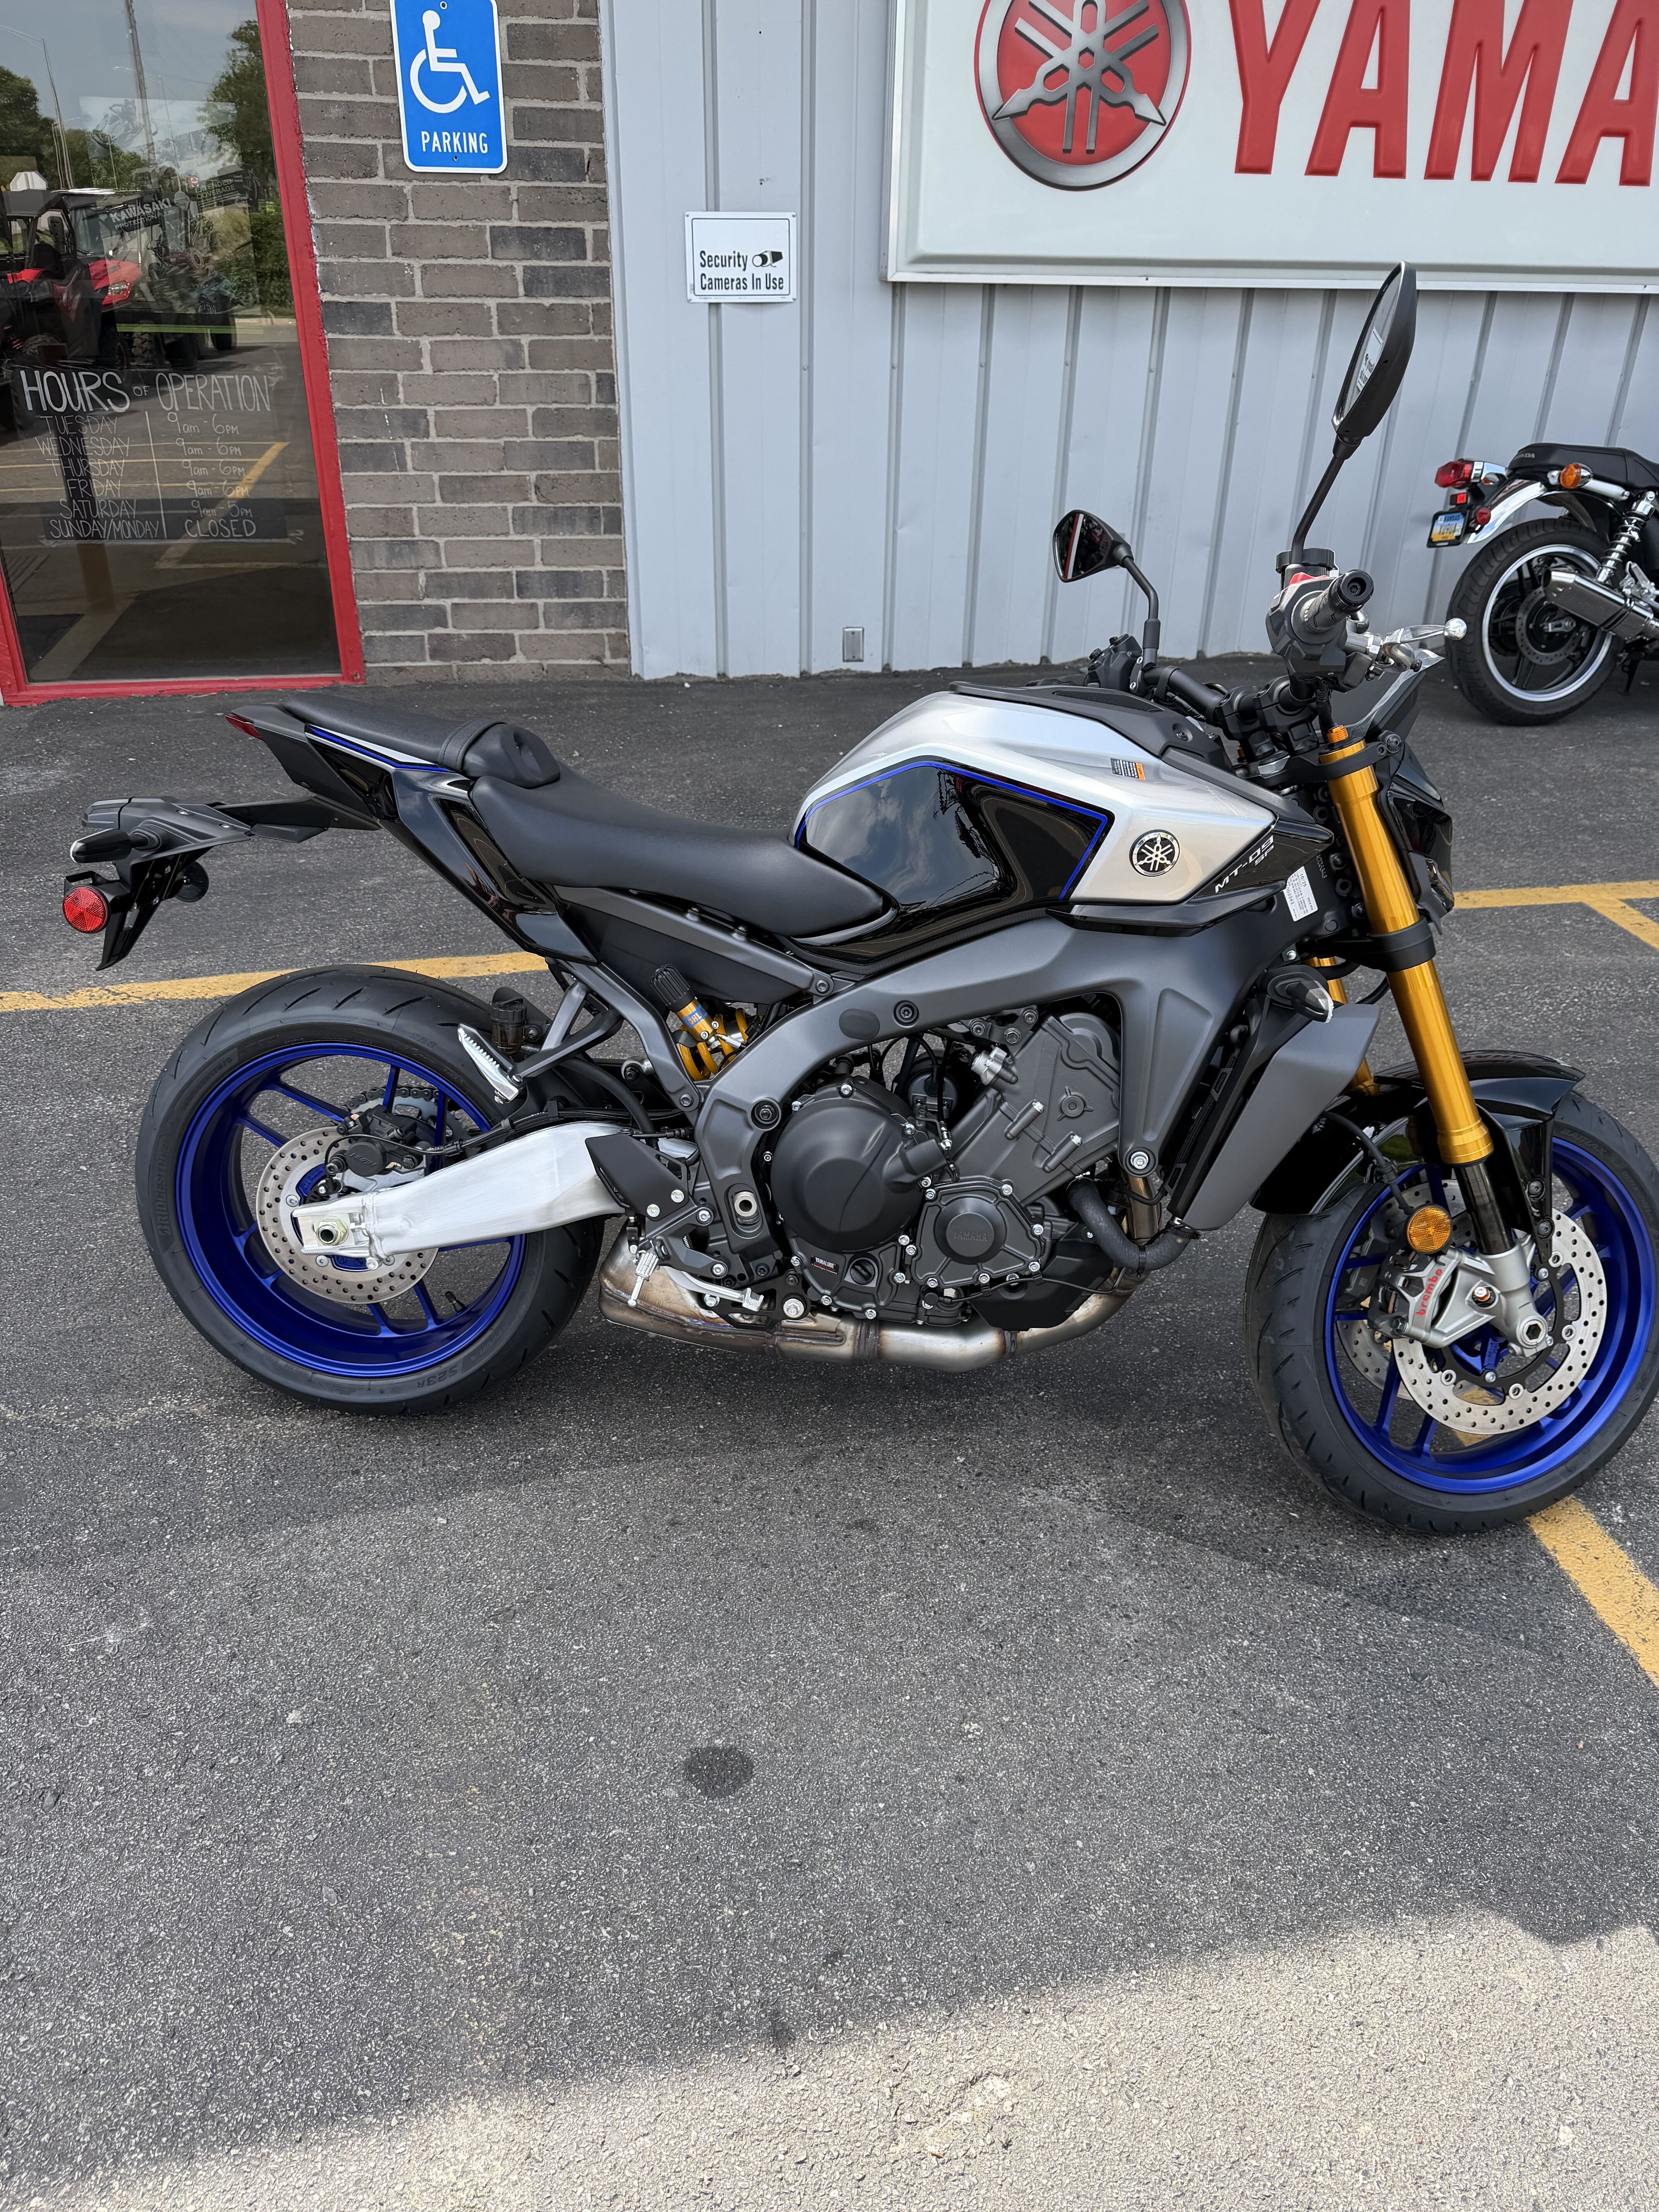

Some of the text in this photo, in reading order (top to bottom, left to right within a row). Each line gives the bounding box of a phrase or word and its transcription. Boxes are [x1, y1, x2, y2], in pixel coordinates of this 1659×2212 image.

[1230, 0, 1659, 186] YAMA
[421, 131, 489, 154] PARKING
[195, 179, 232, 193] EXTENDED
[196, 184, 236, 200] COVERAGE
[110, 198, 172, 223] KAWASAKI
[115, 214, 157, 230] PROTECTION
[699, 250, 748, 271] Security
[700, 273, 748, 290] Cameras
[752, 273, 761, 290] In
[765, 273, 784, 290] Use
[20, 370, 271, 412] HOURS OF OPERATION
[39, 415, 118, 435] TUESDAY
[167, 412, 200, 433] 9am
[35, 436, 130, 457] WEDNESDAY
[175, 437, 203, 456] 9am
[46, 458, 125, 477] THURSDAY
[182, 459, 209, 477] 9am
[66, 478, 121, 498] FRIDAY
[187, 480, 213, 497] 9am
[60, 498, 136, 519] SATURDAY
[191, 500, 217, 517] 9am
[50, 519, 159, 539] SUNDAY/MONDAY
[185, 519, 256, 538] CLOSED
[1215, 835, 1274, 894] MT-09
[953, 1229, 988, 1242] YAMAHA
[1415, 1268, 1443, 1317] brembo
